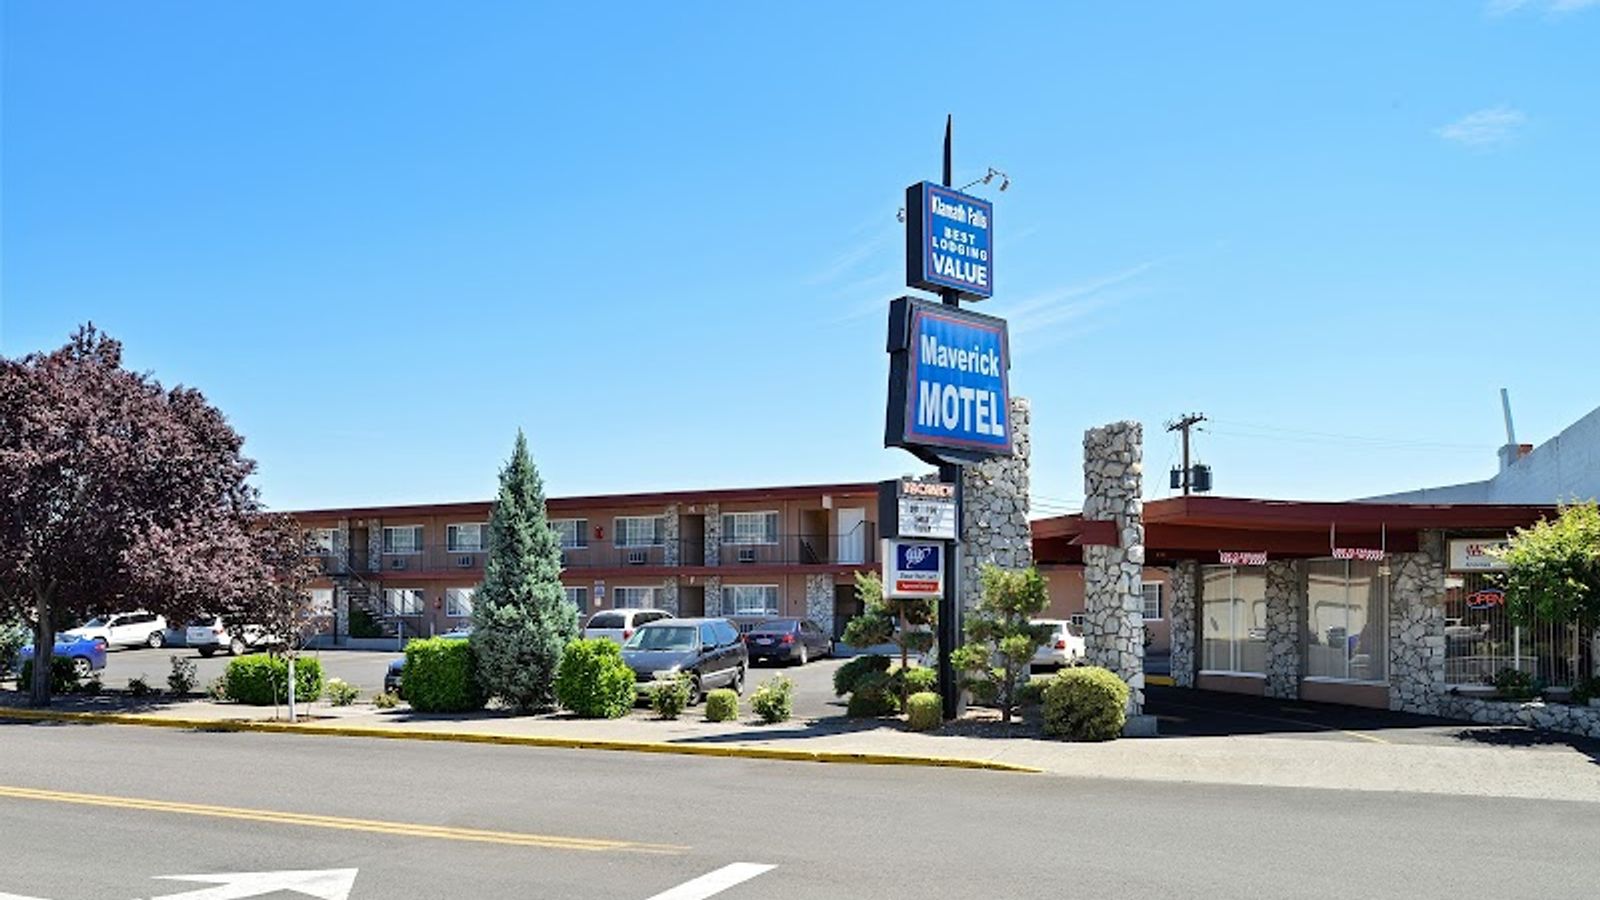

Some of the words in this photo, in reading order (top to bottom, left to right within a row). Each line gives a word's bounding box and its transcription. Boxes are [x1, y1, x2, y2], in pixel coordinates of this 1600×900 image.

[932, 195, 967, 223] Klamath
[968, 206, 987, 230] Falls
[932, 236, 987, 261] LODGING
[944, 226, 976, 245] BEST
[932, 252, 987, 286] VALUE
[920, 333, 999, 377] Maverick
[918, 380, 1005, 437] MOTEL
[1465, 590, 1506, 608] OPEN
